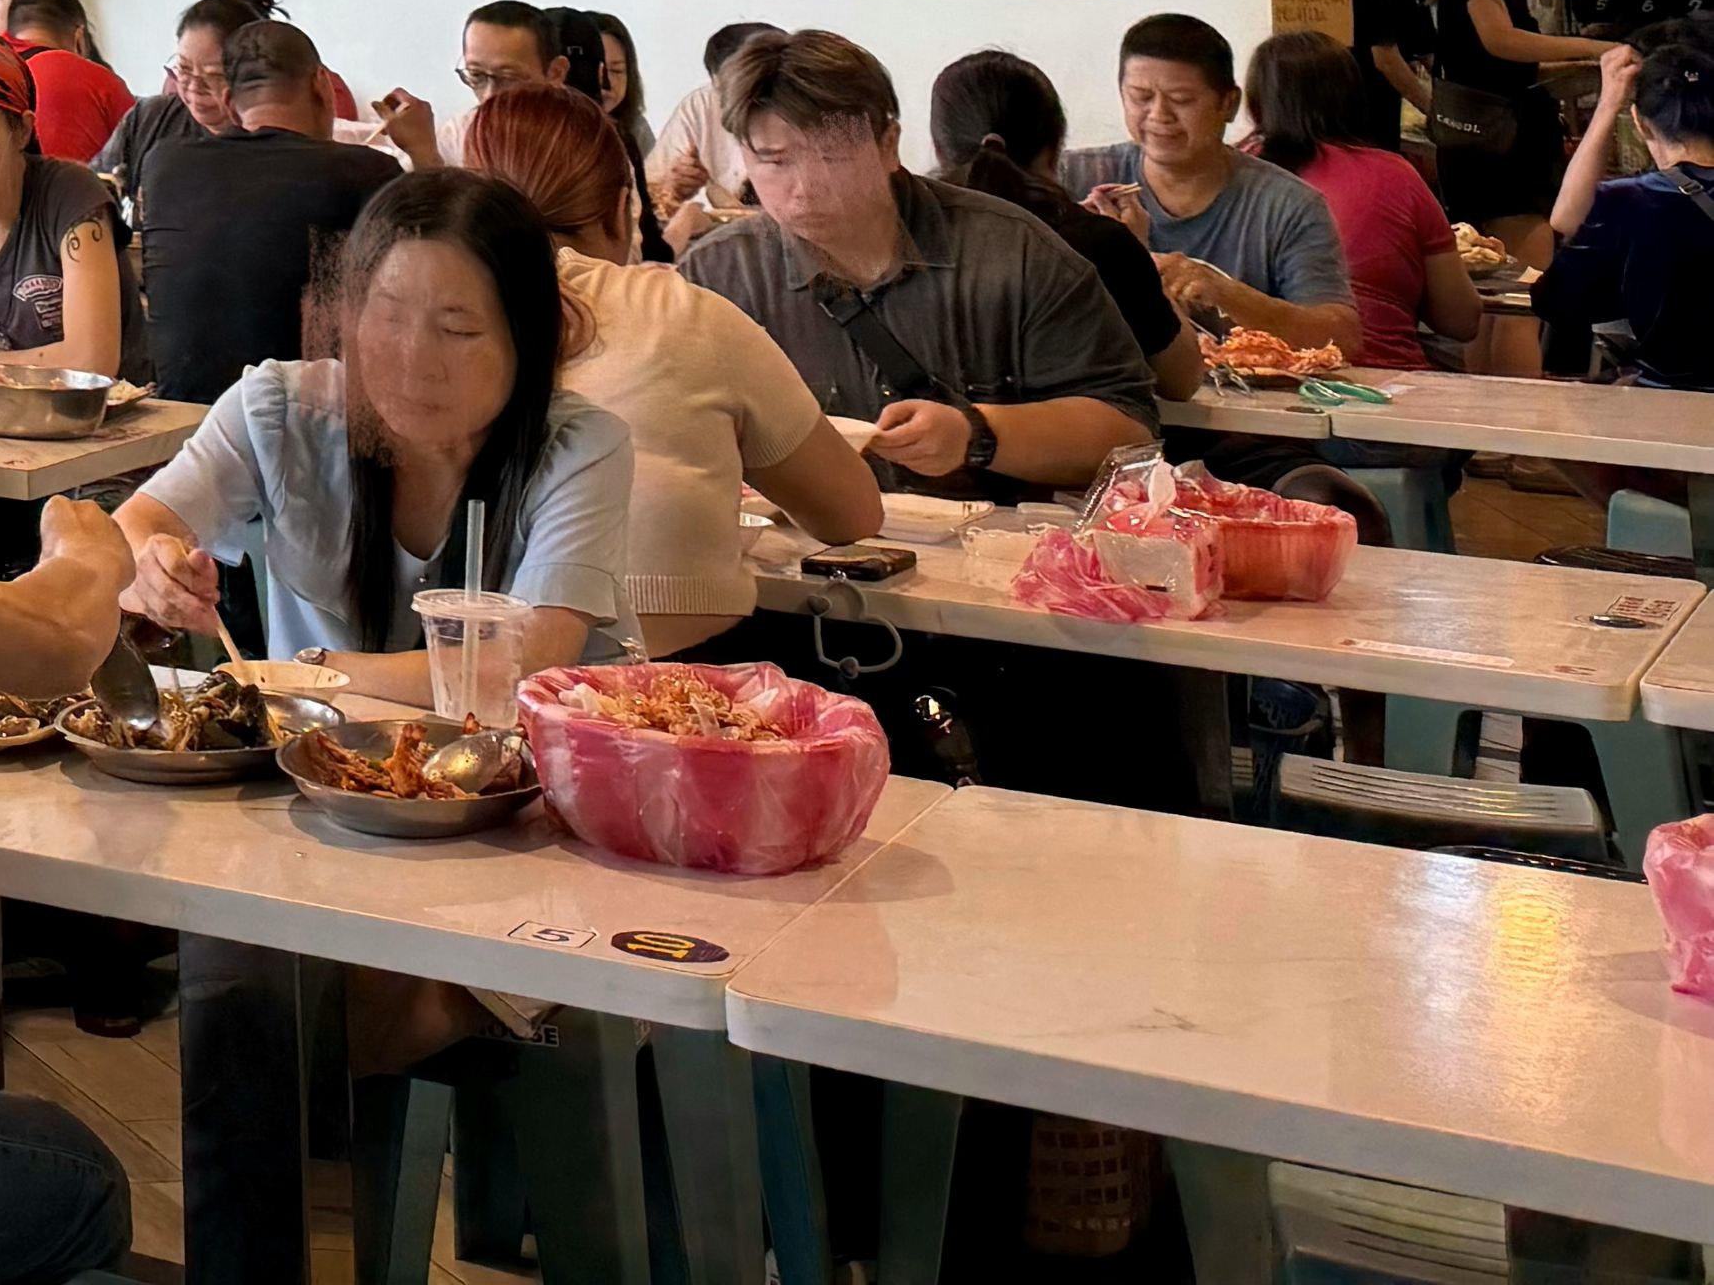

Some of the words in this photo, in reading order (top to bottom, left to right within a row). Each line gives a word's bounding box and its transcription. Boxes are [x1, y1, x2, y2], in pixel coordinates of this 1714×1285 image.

[1642, 0, 1654, 13] 6
[1688, 0, 1703, 12] 7
[532, 928, 575, 943] 5
[627, 933, 696, 959] 10
